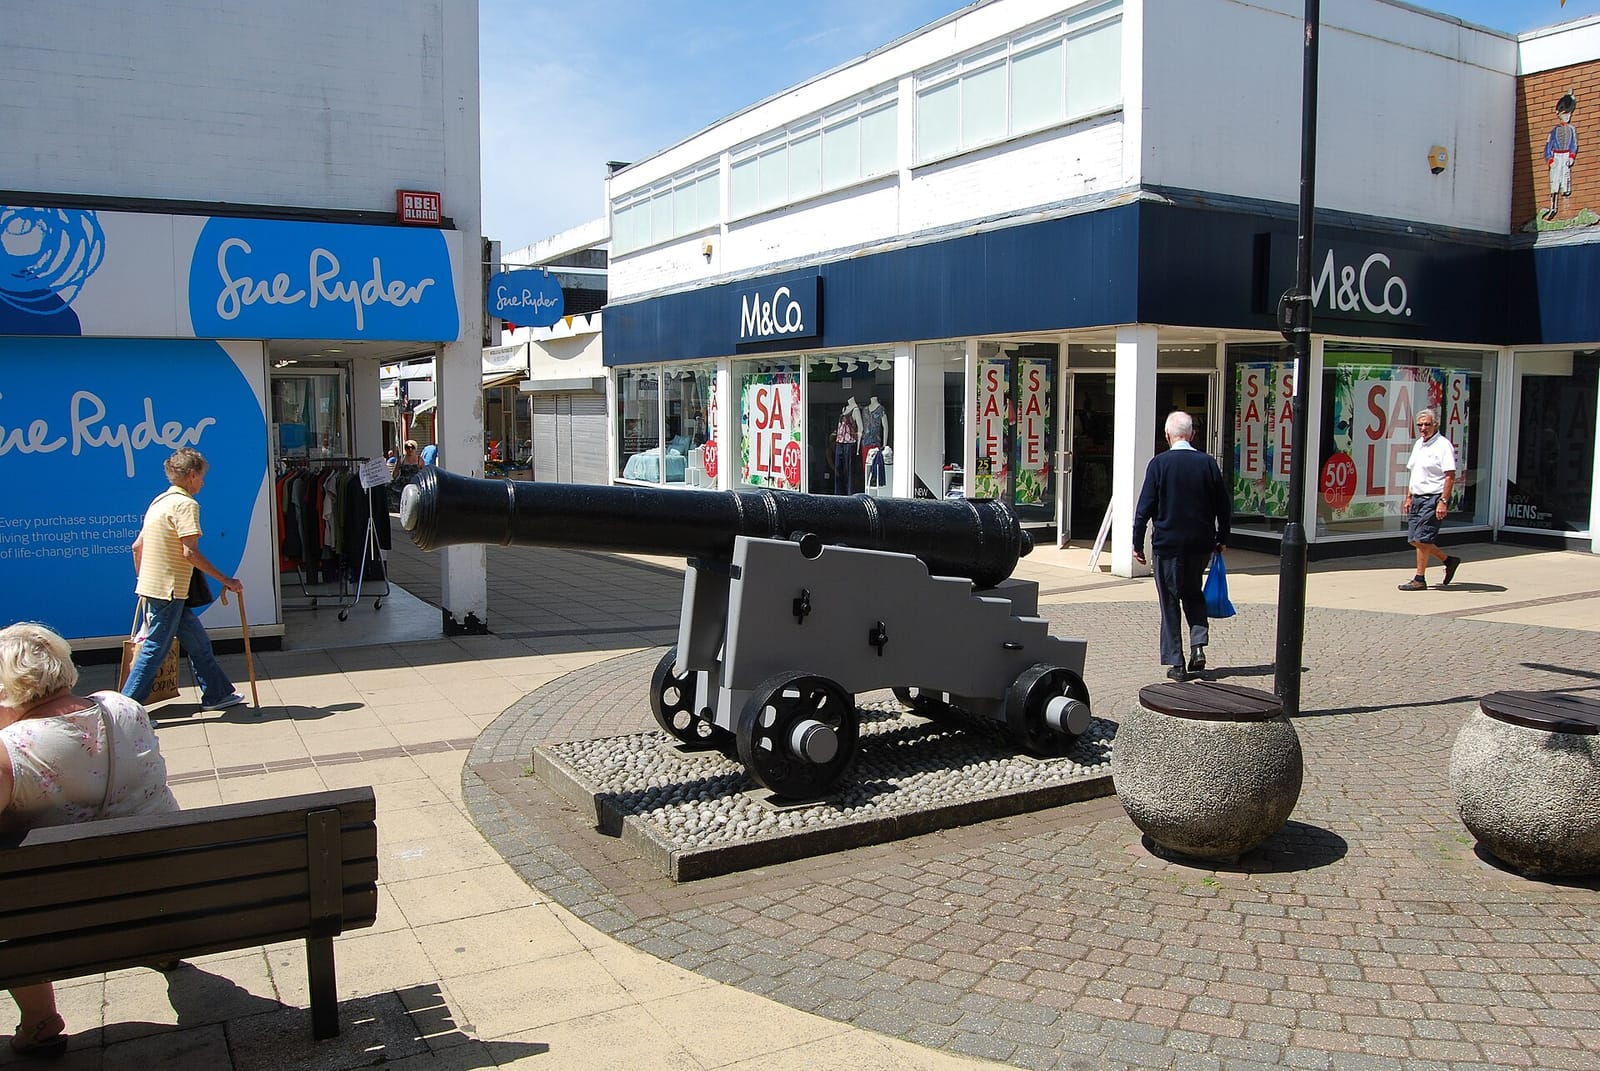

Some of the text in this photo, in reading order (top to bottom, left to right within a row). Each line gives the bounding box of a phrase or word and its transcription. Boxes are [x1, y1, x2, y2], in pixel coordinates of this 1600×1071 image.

[405, 196, 436, 210] ABEL
[405, 209, 437, 220] ALARM
[217, 238, 435, 331] Sue Ryder
[496, 286, 559, 315] Sue Ryder
[741, 286, 804, 338] M&Co.
[1025, 369, 1041, 463] SALE
[1244, 374, 1260, 472] SALE
[1279, 374, 1293, 474] SALE
[0, 390, 216, 478] ue Ryder
[785, 466, 797, 480] OFF
[1325, 461, 1355, 488] 50%
[1325, 486, 1346, 504] OFF
[0, 517, 32, 530] Every
[33, 515, 87, 529] purchase
[88, 513, 138, 526] supports
[1507, 503, 1537, 520] MENS
[0, 527, 141, 545] living through the challen
[0, 544, 131, 560] of life-changing illnesse
